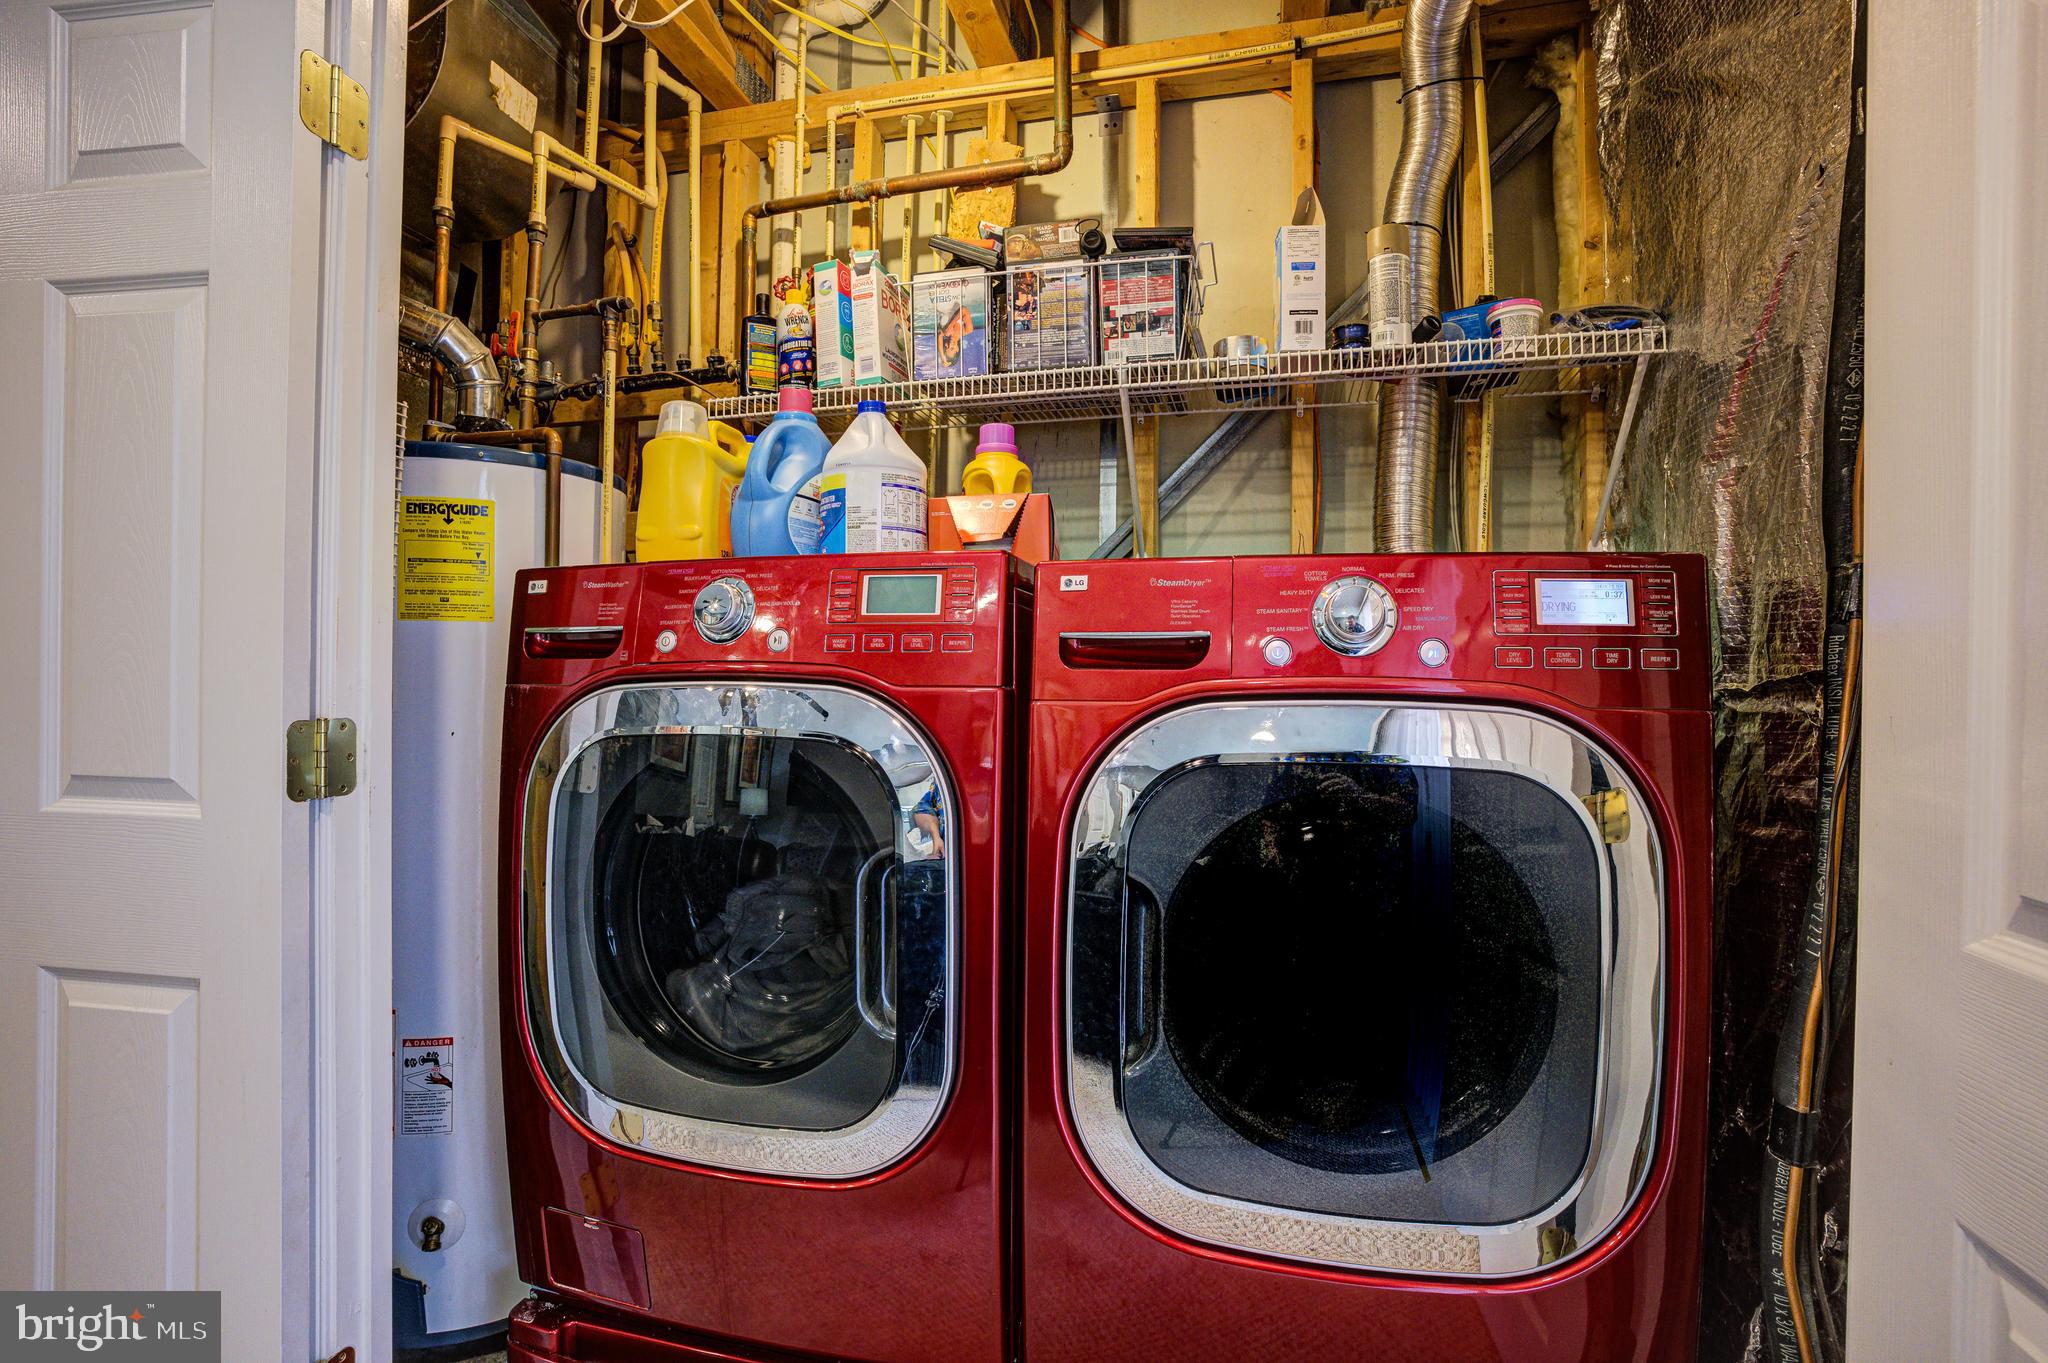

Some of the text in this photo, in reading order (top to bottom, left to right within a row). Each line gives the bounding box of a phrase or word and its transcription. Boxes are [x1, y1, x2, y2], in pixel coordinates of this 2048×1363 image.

[1234, 43, 1282, 57] CHARLOTTE
[784, 315, 809, 326] WRENCH
[405, 502, 489, 518] ENERGYGUIDE
[1605, 590, 1624, 599] 0:37
[1542, 601, 1576, 611] DRYING
[1826, 634, 1846, 676] Rubatex
[414, 1038, 451, 1047] DANGER
[1774, 1293, 1787, 1306] ID
[1776, 1307, 1786, 1315] x
